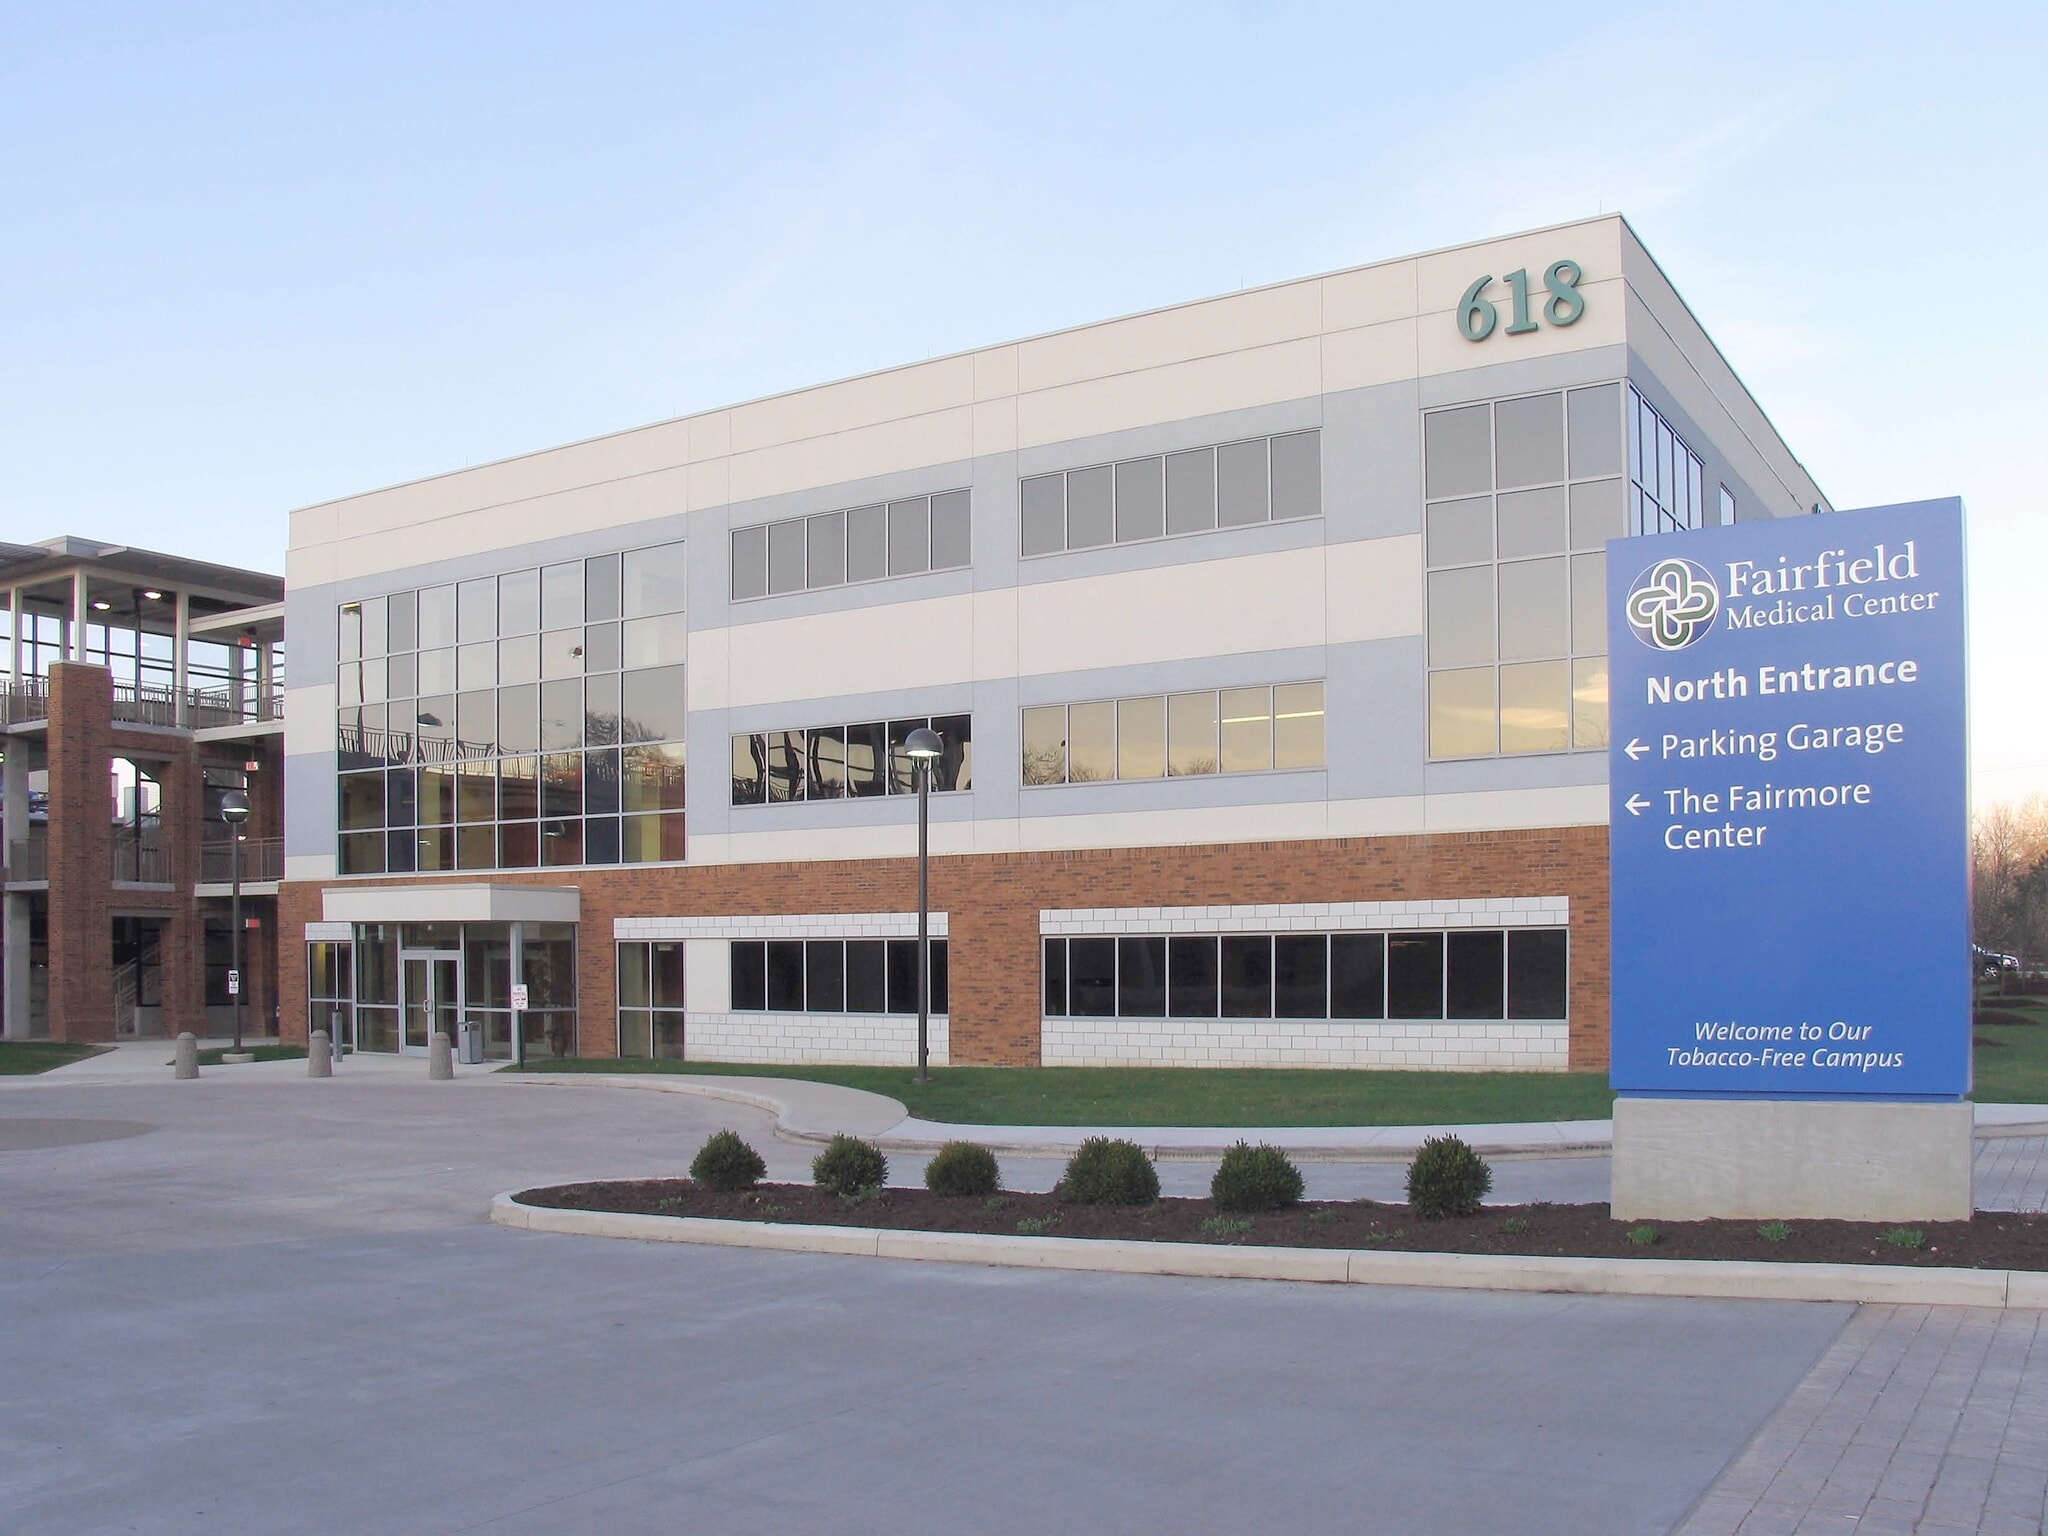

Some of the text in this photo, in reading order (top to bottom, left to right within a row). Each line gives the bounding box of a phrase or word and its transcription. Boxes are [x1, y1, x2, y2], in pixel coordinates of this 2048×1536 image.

[1456, 259, 1585, 342] 618
[1725, 540, 1919, 598] Fairfield
[1726, 588, 1939, 630] Medical Center
[1646, 659, 1918, 704] North Entrance
[1661, 721, 1905, 762] Parking Garage
[1663, 782, 1872, 816] The Fairmore
[1663, 821, 1767, 851] Center
[1694, 1021, 1872, 1041] Welcome to Our
[1667, 1047, 1904, 1073] Tobacco-Free Campus
